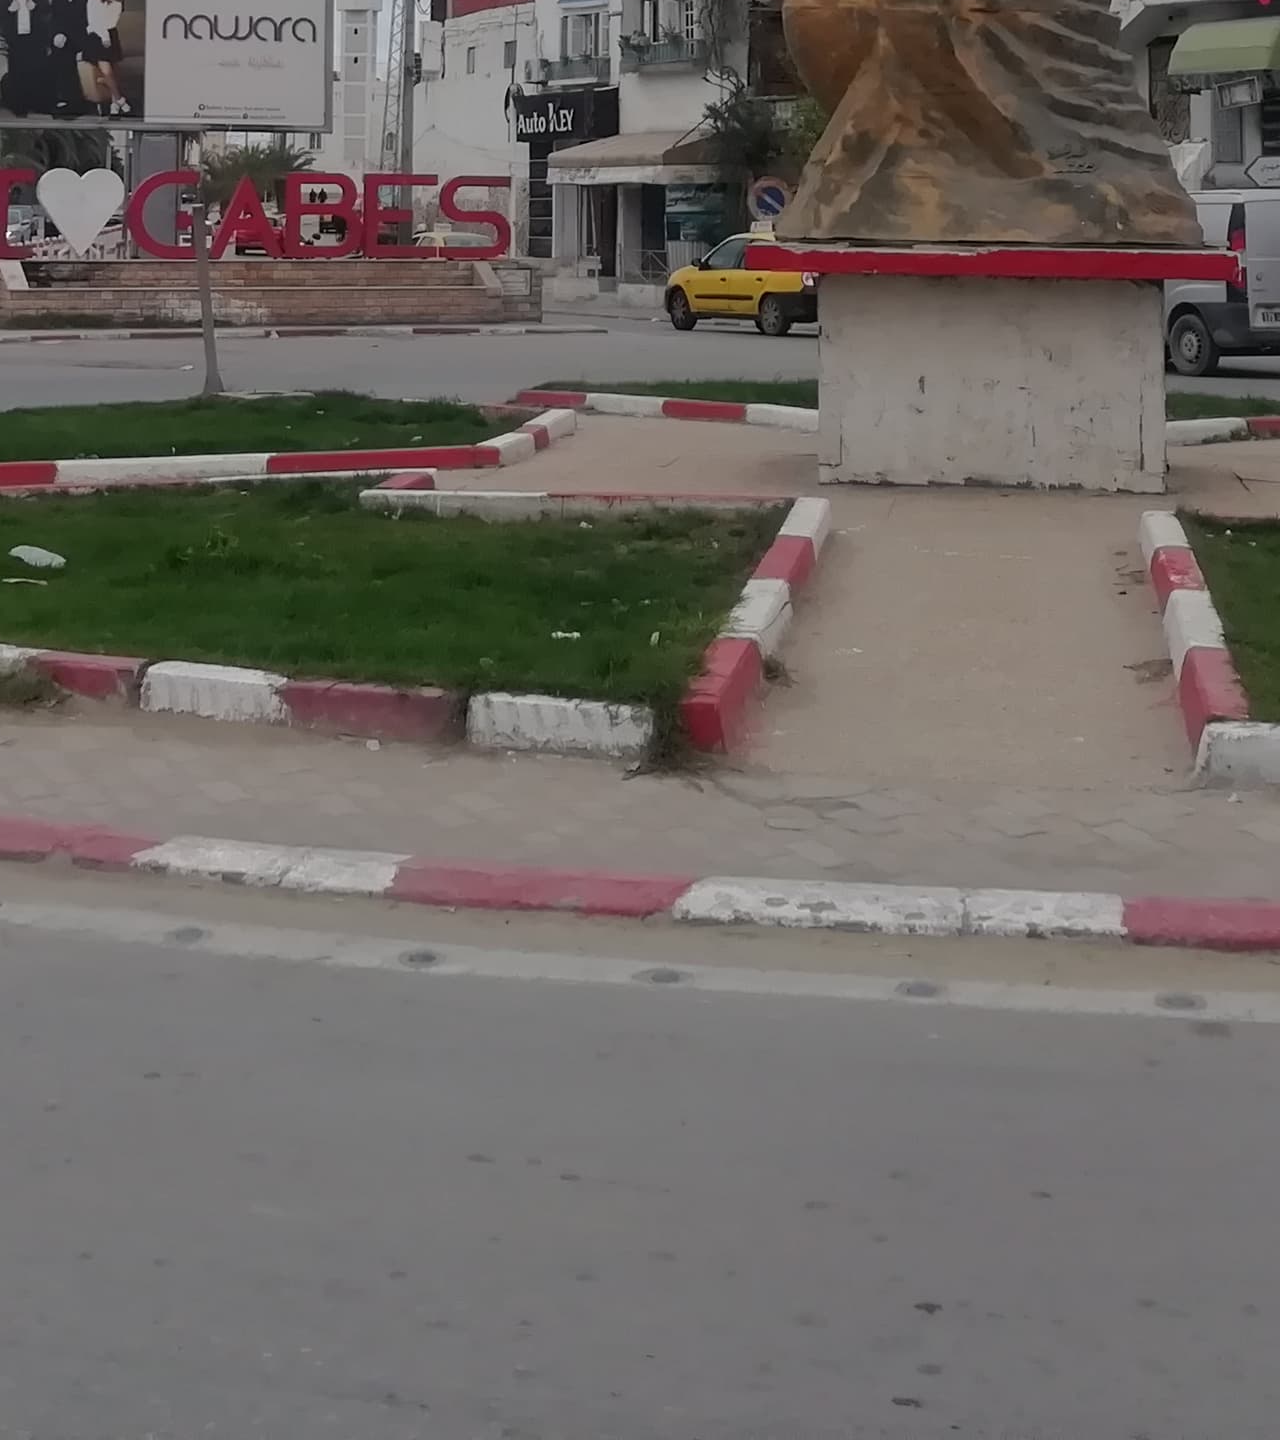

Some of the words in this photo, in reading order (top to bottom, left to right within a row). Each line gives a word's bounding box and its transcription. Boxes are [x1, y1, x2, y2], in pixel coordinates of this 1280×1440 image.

[162, 13, 317, 43] nawara
[517, 111, 546, 134] Auto
[124, 170, 511, 260] GABES
